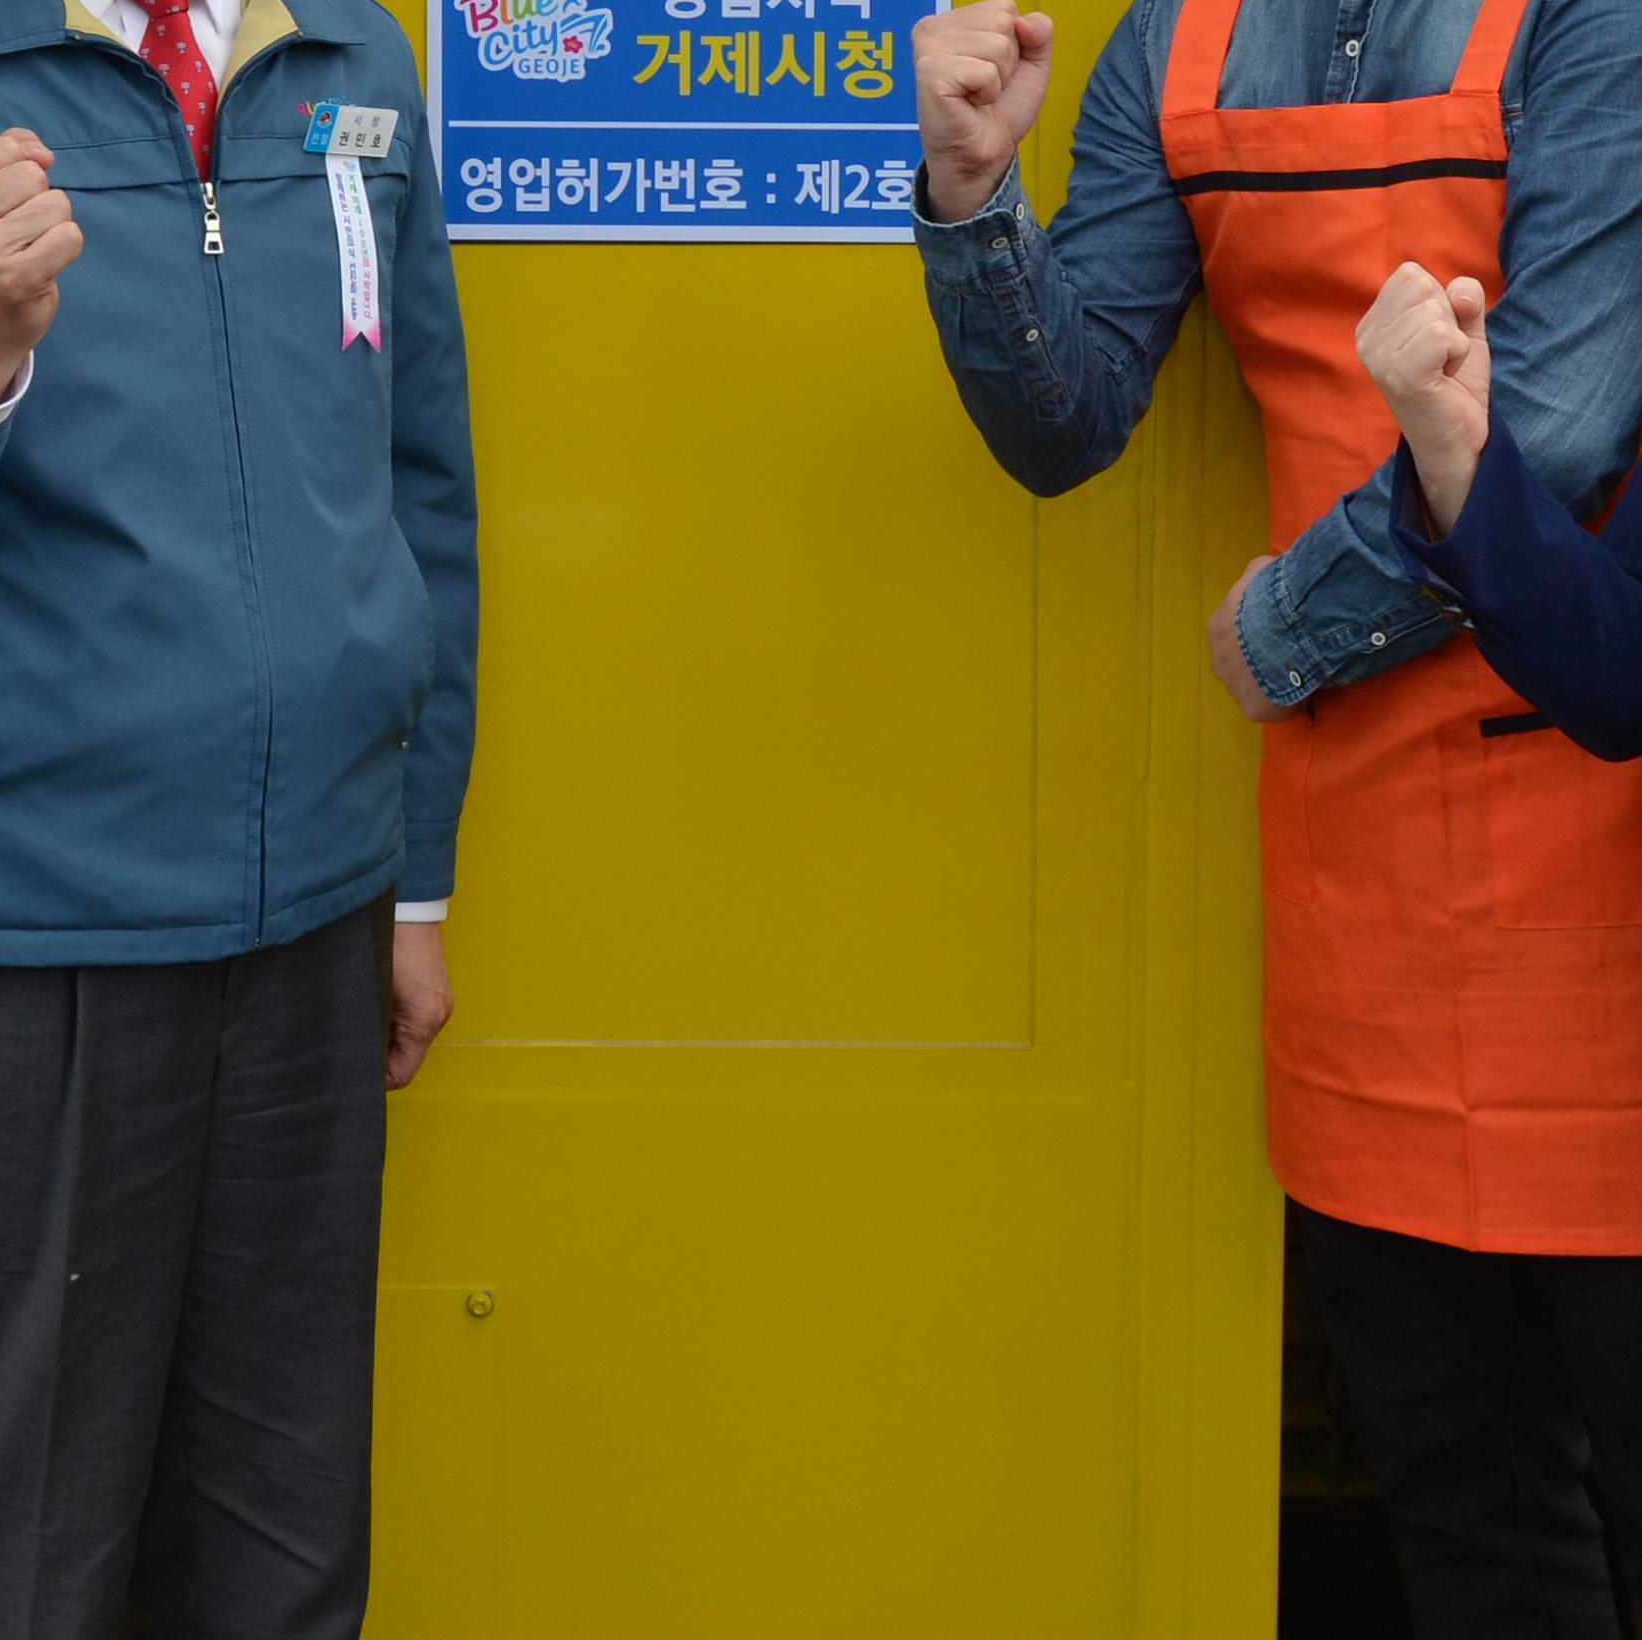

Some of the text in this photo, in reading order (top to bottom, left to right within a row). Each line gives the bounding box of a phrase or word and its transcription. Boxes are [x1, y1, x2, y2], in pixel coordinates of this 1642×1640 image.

[483, 18, 559, 64] City
[518, 58, 581, 77] GEOJE
[632, 29, 894, 99] 거제시청
[460, 156, 746, 215] 영업허가번호
[794, 158, 913, 216] 제2호
